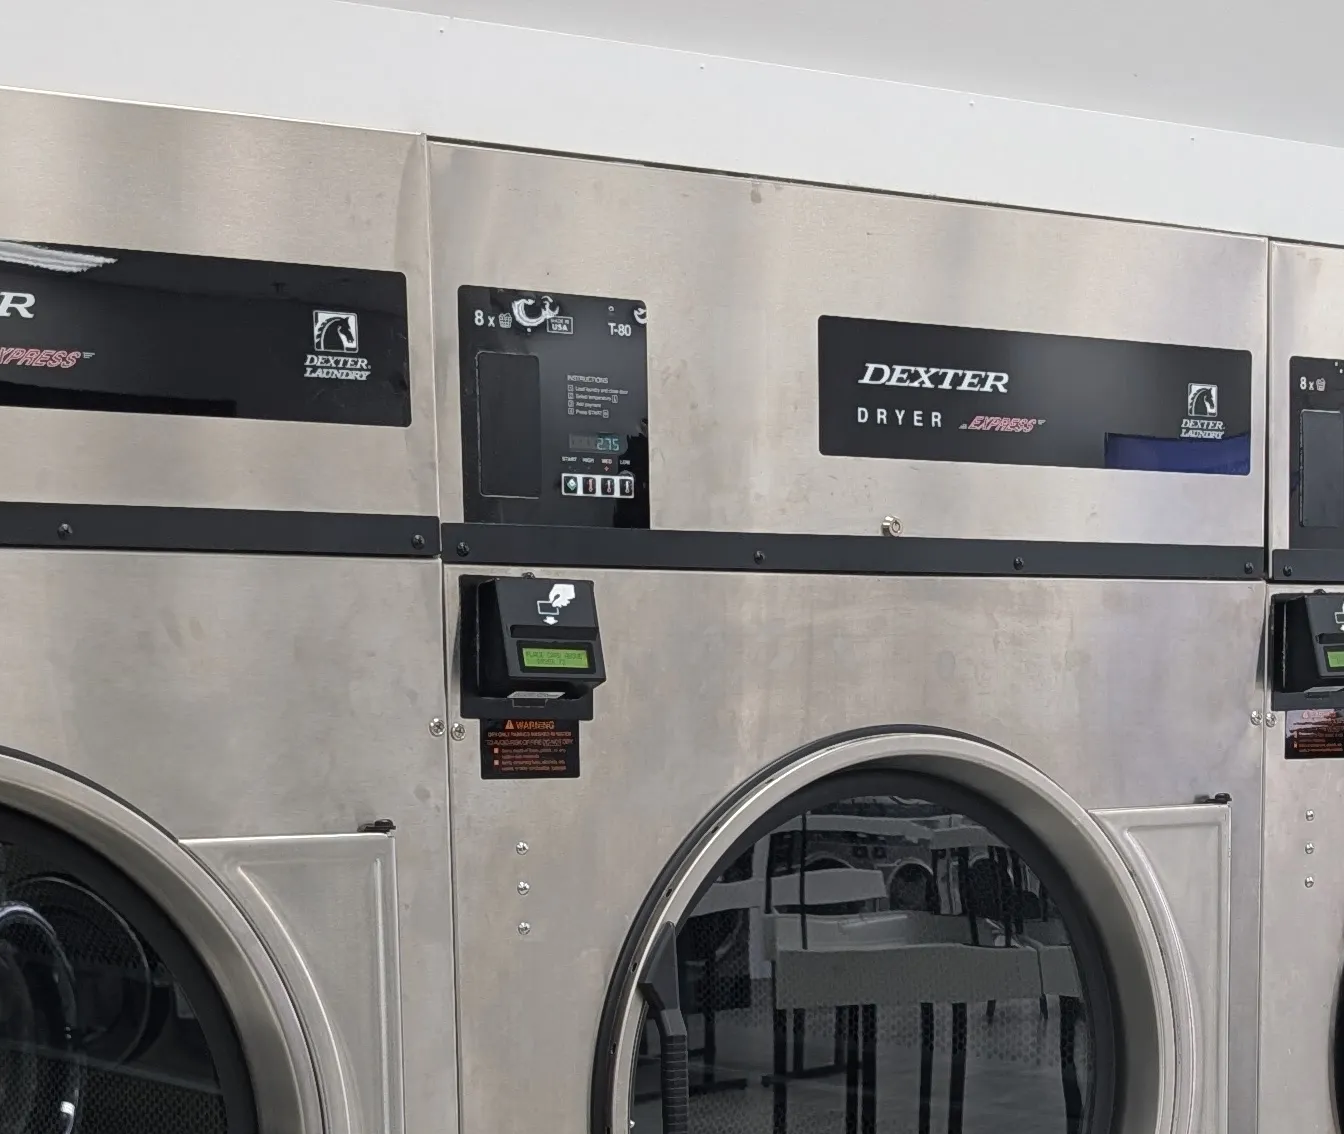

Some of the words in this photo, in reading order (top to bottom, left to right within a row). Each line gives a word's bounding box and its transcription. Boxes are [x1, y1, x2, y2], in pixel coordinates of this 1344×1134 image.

[474, 310, 484, 326] 8
[488, 316, 496, 328] x
[552, 324, 568, 332] USA
[608, 322, 632, 336] T-80
[304, 354, 368, 370] DEXTER
[304, 368, 371, 380] LAUNDRY
[858, 363, 1009, 393] DEXTER
[1300, 376, 1307, 390] 8
[858, 407, 942, 428] DRYER
[968, 416, 1036, 432] EXPRESS
[1180, 418, 1224, 430] DEXTER
[1180, 429, 1224, 440] LAUNDRY
